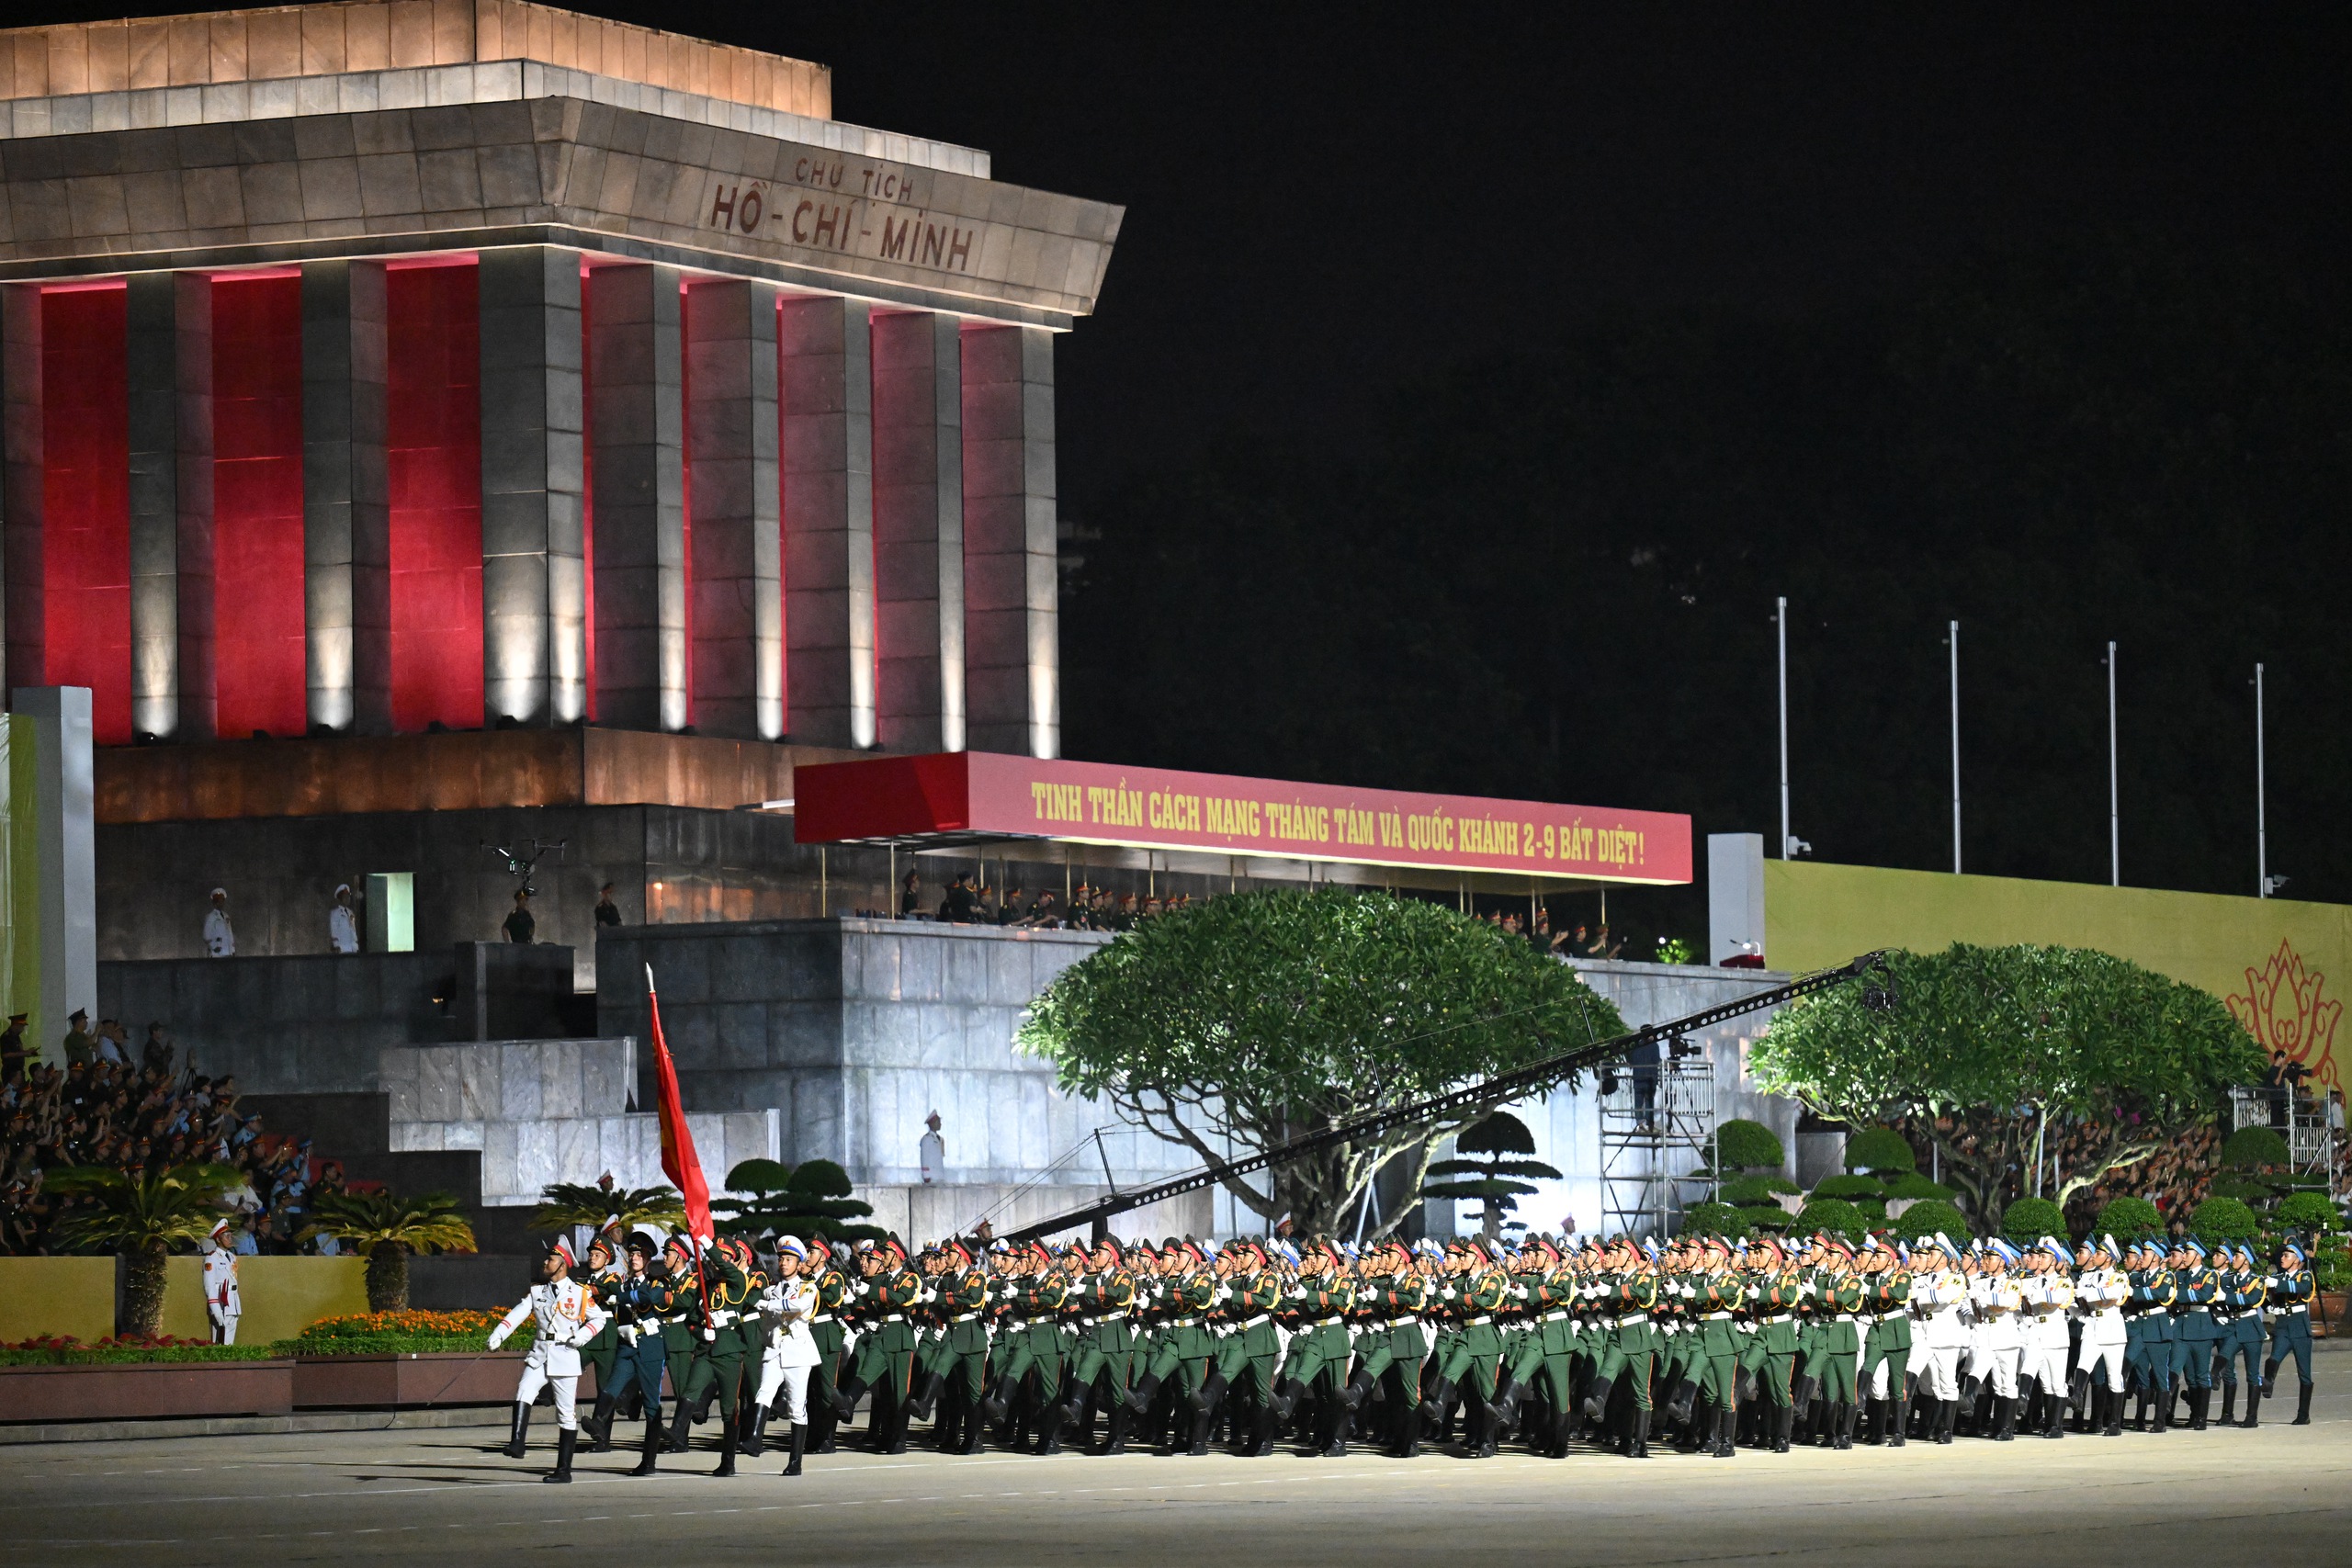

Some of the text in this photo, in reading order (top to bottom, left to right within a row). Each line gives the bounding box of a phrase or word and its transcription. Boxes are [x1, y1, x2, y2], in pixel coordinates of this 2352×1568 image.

[1031, 776, 1645, 871] TINH THẦN CÁCH MẠNG THÁNG TÁM VÀ QUỐC KHÁNH 2-9 BẤT DIỆT!
